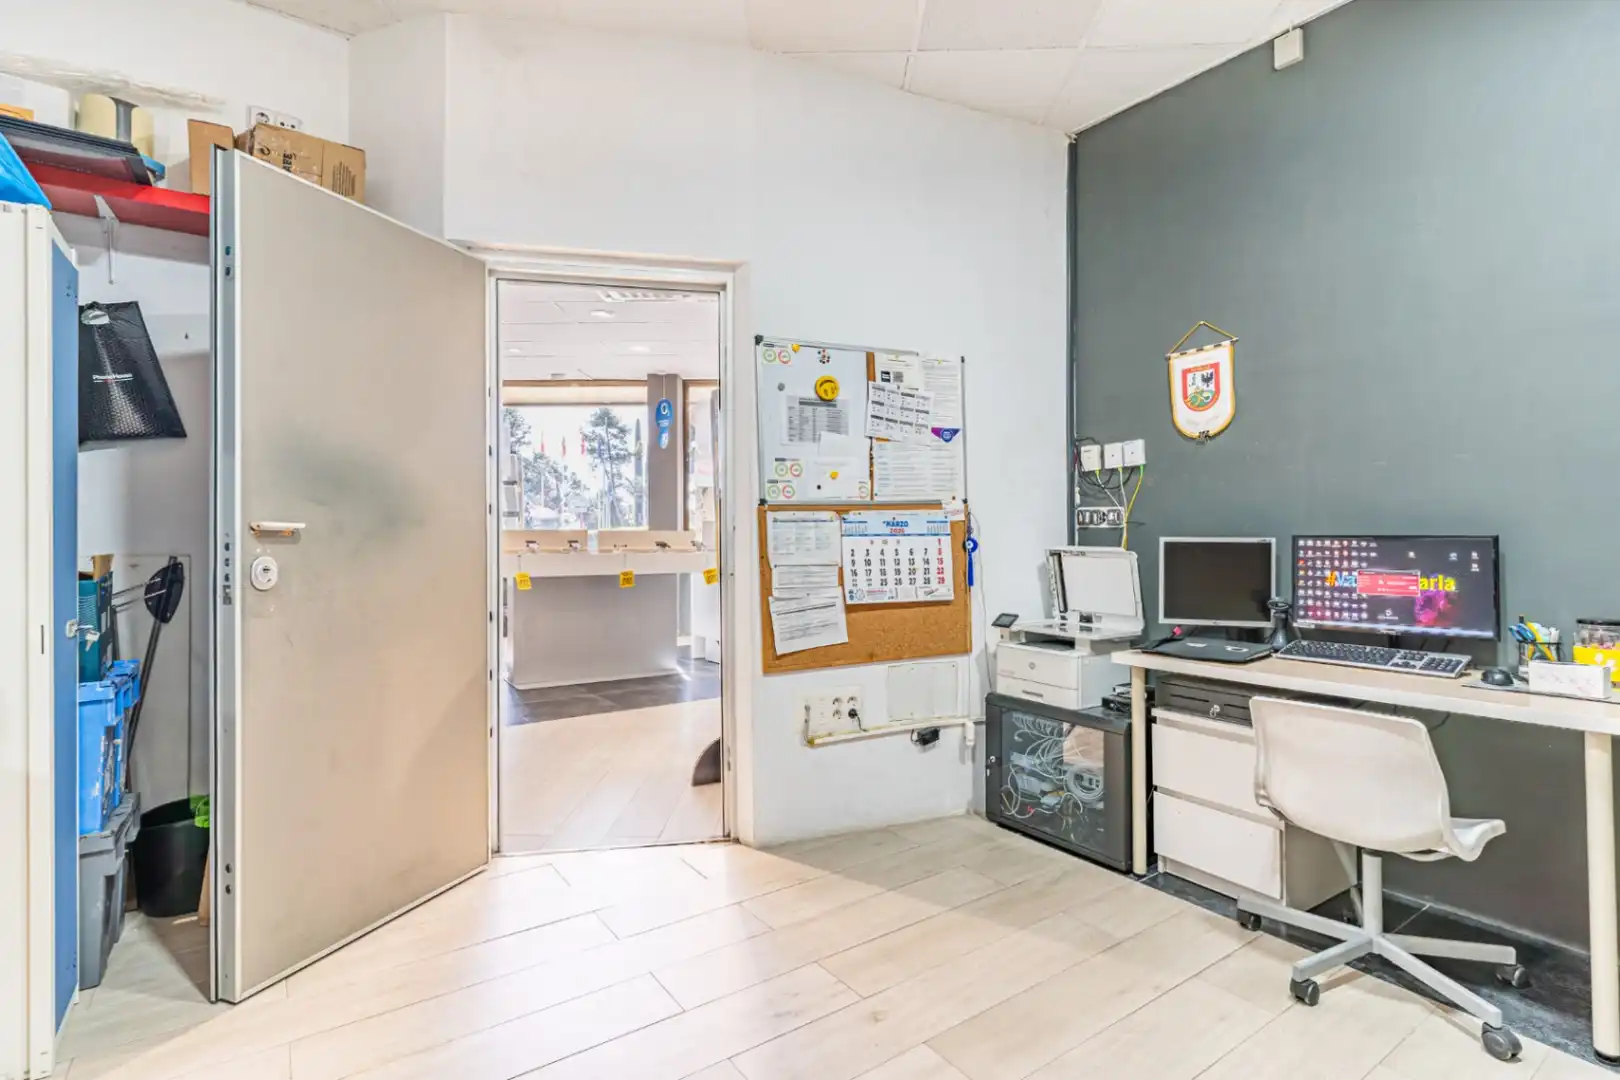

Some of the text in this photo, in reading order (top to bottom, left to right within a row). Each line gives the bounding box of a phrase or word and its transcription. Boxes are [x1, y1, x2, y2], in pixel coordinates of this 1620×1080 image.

[938, 538, 941, 546] 1
[850, 548, 855, 557] 2
[865, 548, 870, 557] 3
[879, 548, 884, 557] 4
[909, 548, 914, 556] 6
[851, 558, 856, 567] 9
[864, 558, 872, 567] 10
[879, 558, 886, 566] 11
[908, 558, 915, 566] 13
[850, 568, 857, 577] 16
[865, 568, 872, 577] 17
[908, 568, 916, 576] 20
[1326, 570, 1356, 587] #Va
[1420, 574, 1456, 591] arla
